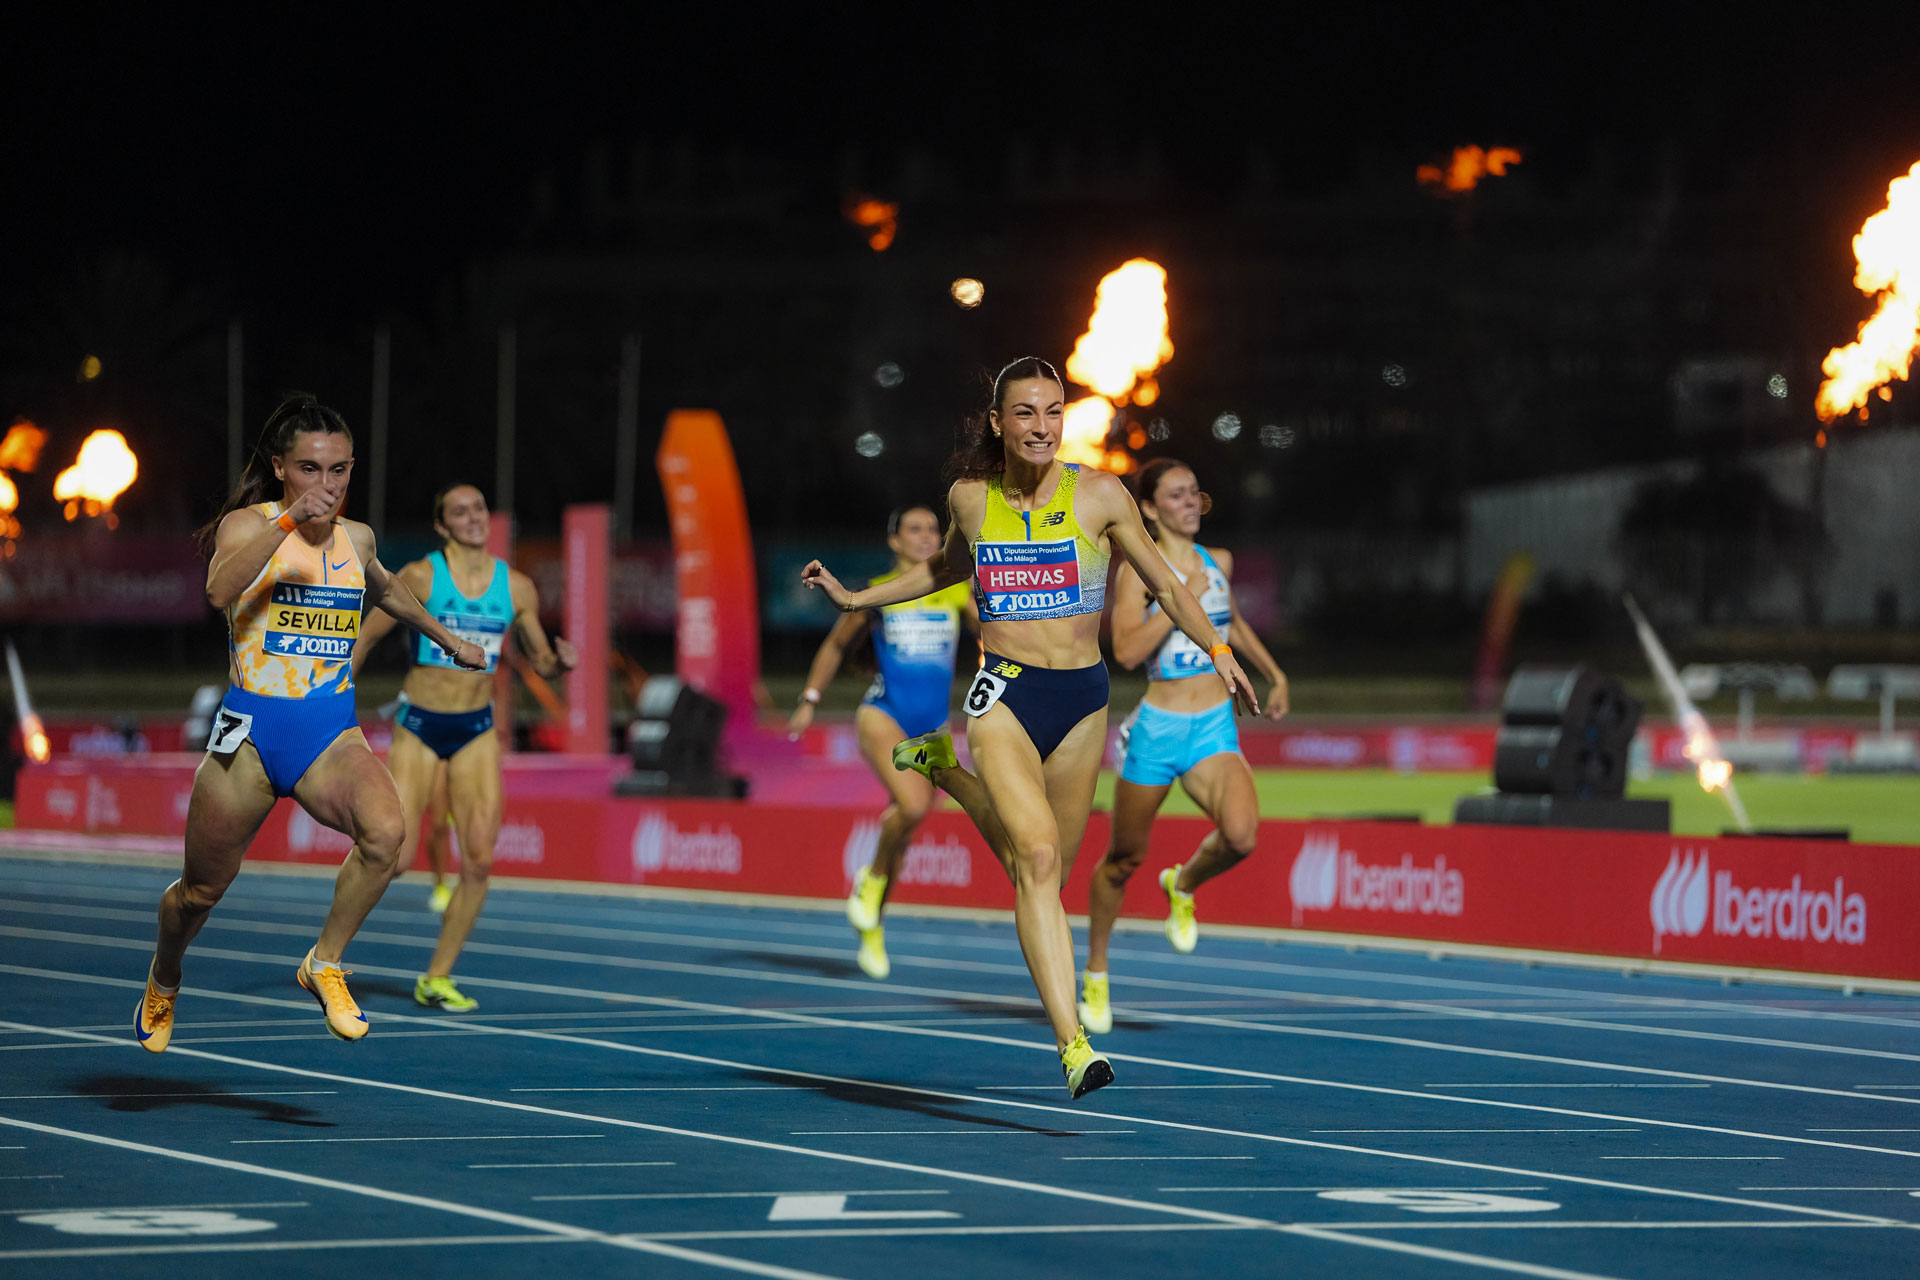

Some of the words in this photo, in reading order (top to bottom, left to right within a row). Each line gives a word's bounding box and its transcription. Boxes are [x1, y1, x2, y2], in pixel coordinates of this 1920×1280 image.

[1003, 547, 1038, 555] Diputación
[1038, 545, 1070, 554] Provincial
[1014, 555, 1037, 563] Málaga
[990, 569, 1066, 587] HERVAS
[304, 588, 336, 598] Diputación
[312, 597, 334, 606] Málaga
[277, 610, 356, 633] SEVILLA
[969, 677, 995, 711] 6
[214, 712, 243, 746] 7
[914, 748, 928, 765] N
[1339, 849, 1464, 916] Iberdrola
[1713, 869, 1867, 945] Iberdrola
[16, 1210, 278, 1236] 8
